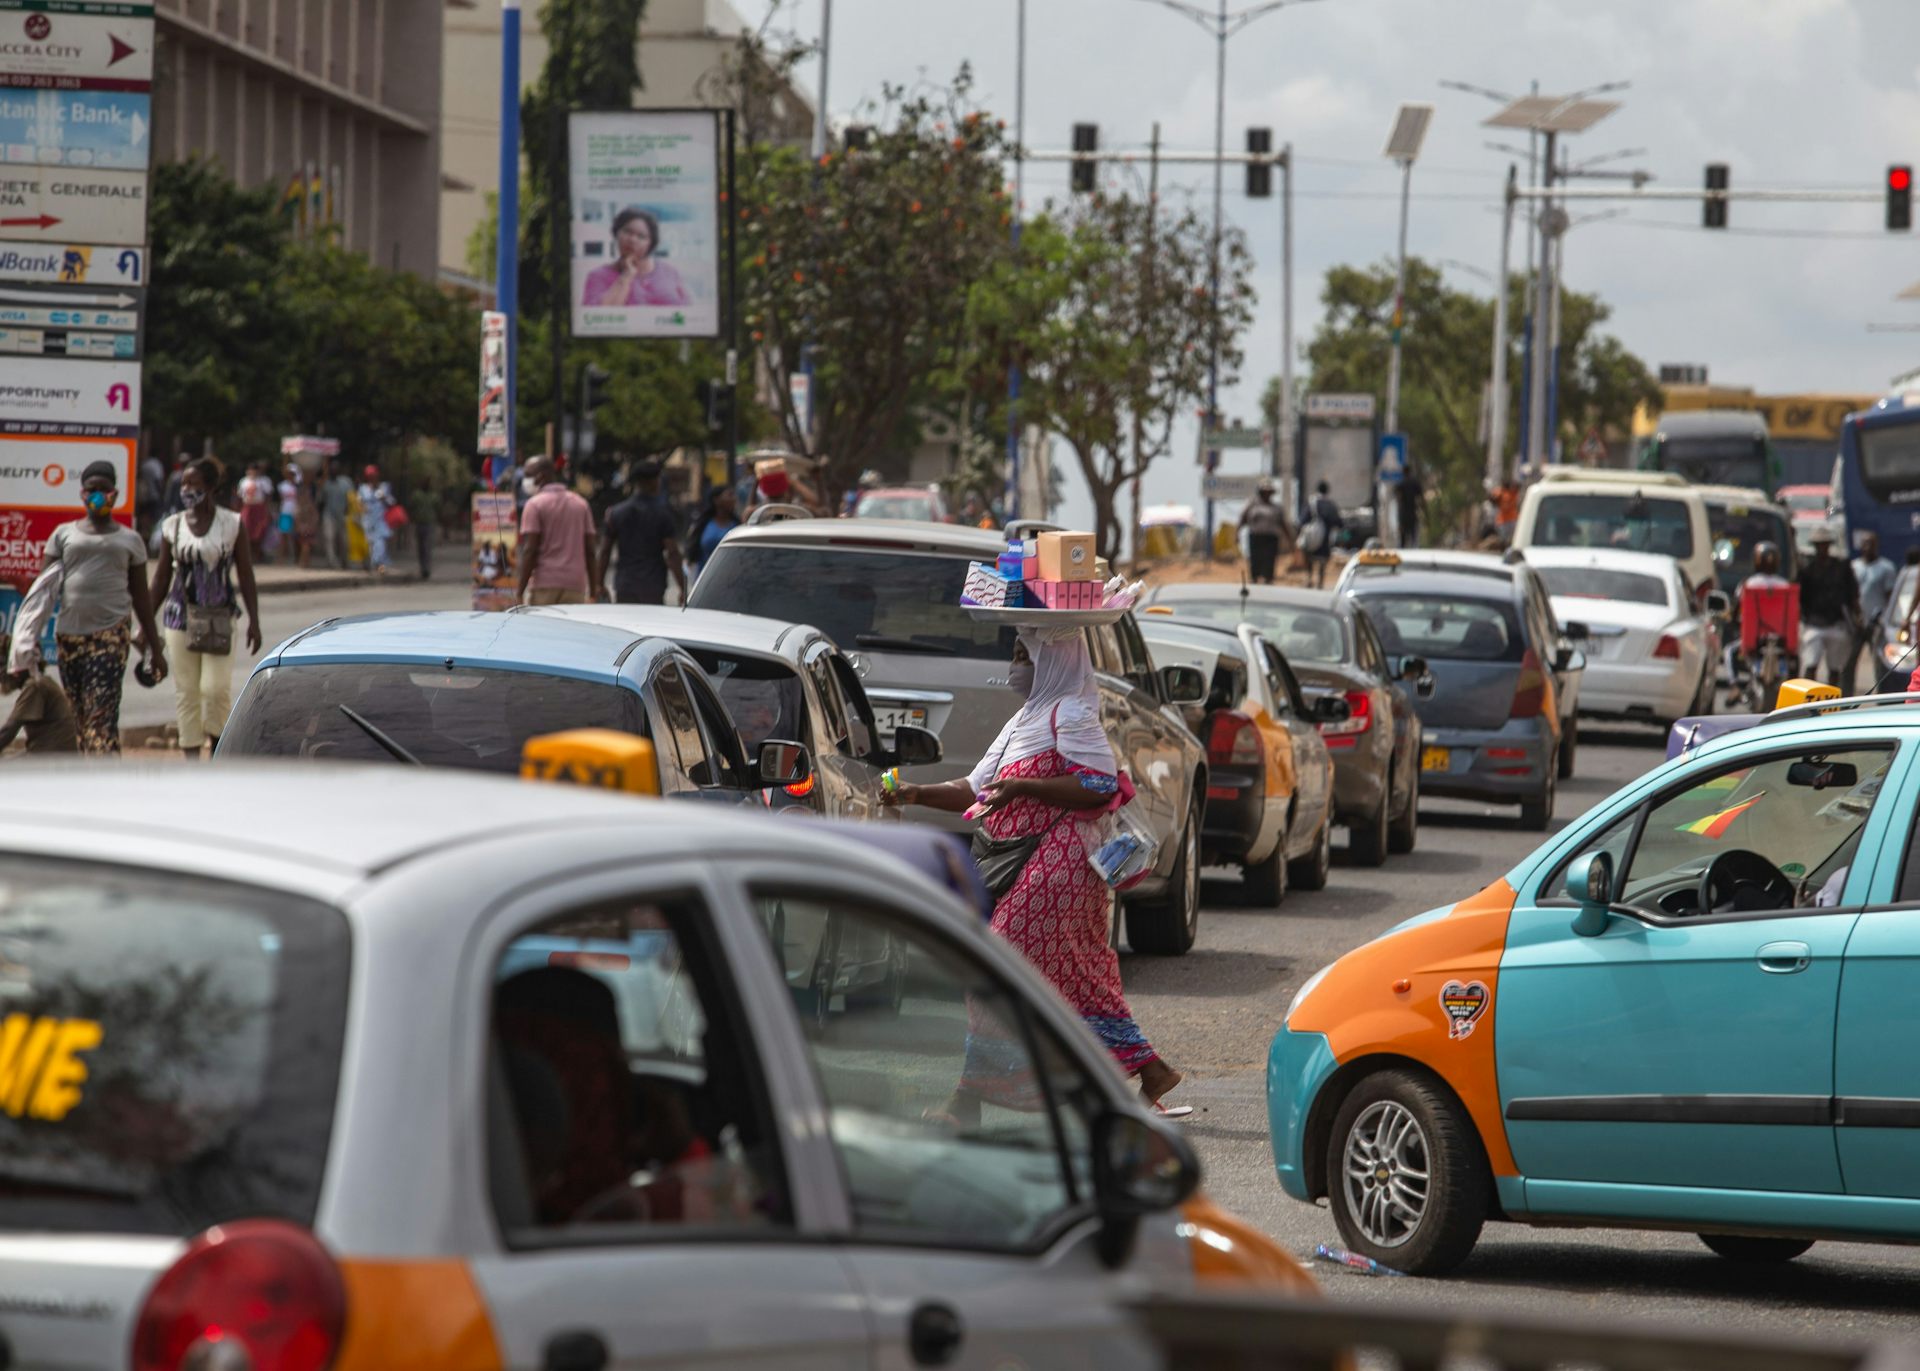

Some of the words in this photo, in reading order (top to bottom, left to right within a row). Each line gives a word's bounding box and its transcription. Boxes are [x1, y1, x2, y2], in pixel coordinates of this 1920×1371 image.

[46, 43, 82, 58] CITY
[72, 102, 123, 125] Bank
[50, 183, 143, 199] GENERALE
[524, 758, 626, 793] TAXI
